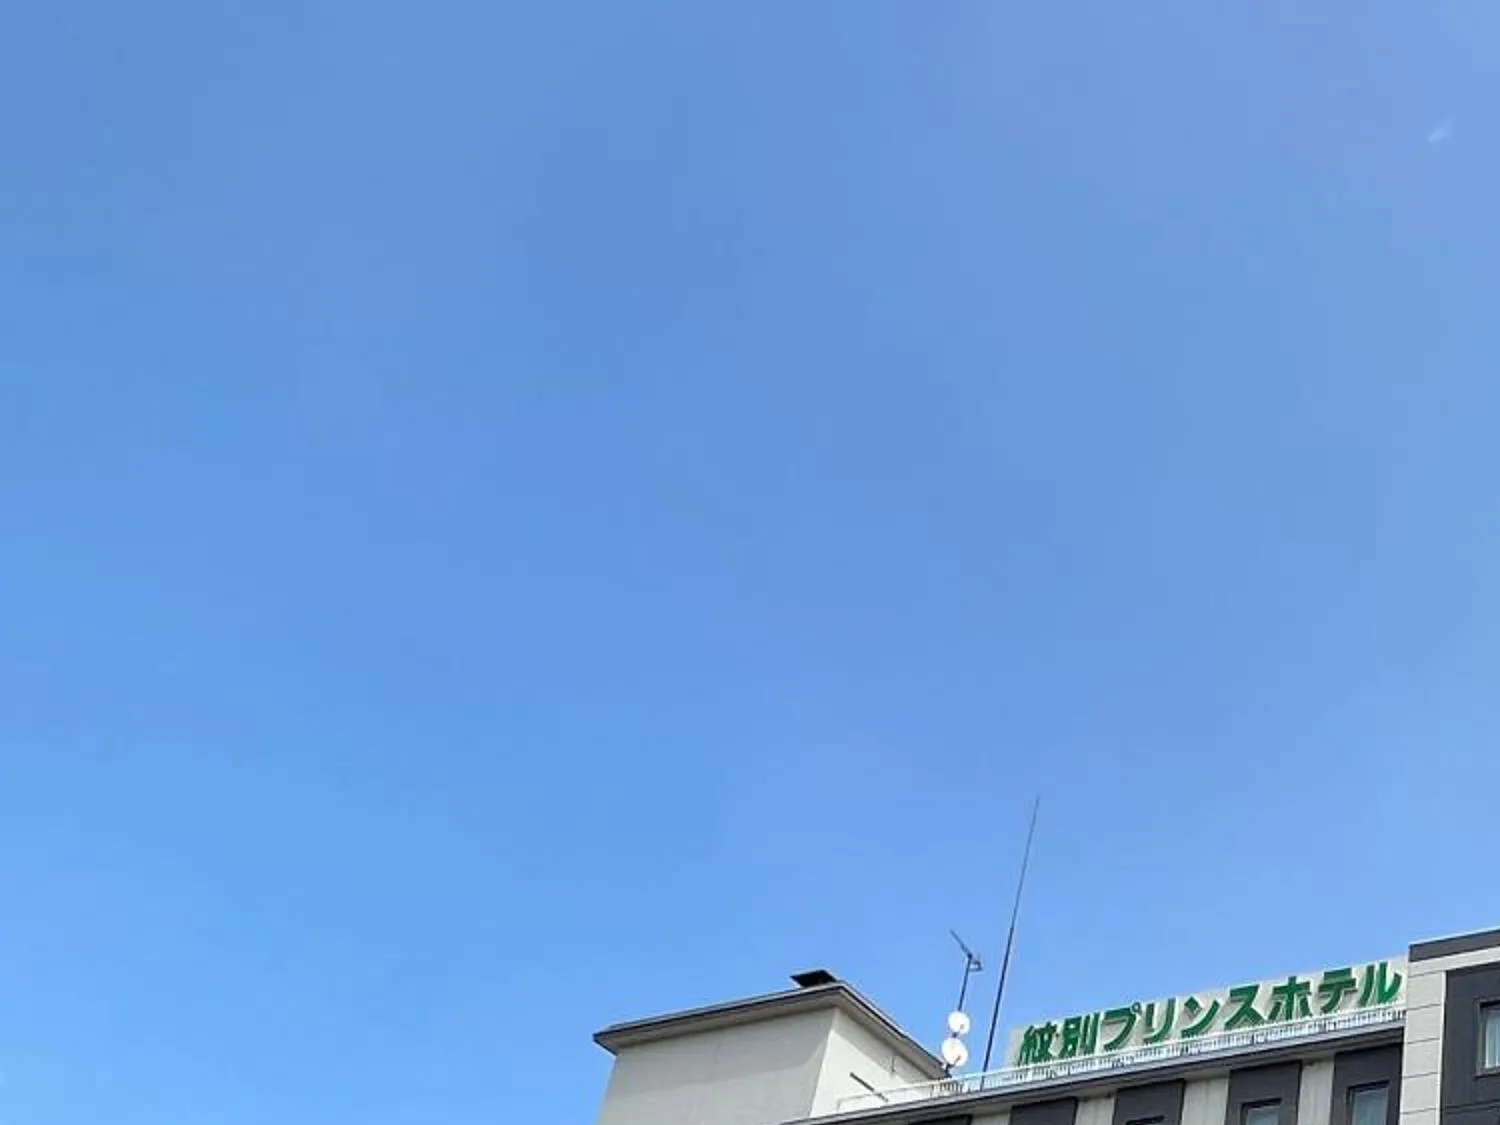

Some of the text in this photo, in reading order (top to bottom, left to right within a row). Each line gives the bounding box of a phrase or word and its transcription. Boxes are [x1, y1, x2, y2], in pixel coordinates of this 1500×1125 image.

[1017, 960, 1401, 1066] 紋別プリンスホテル
